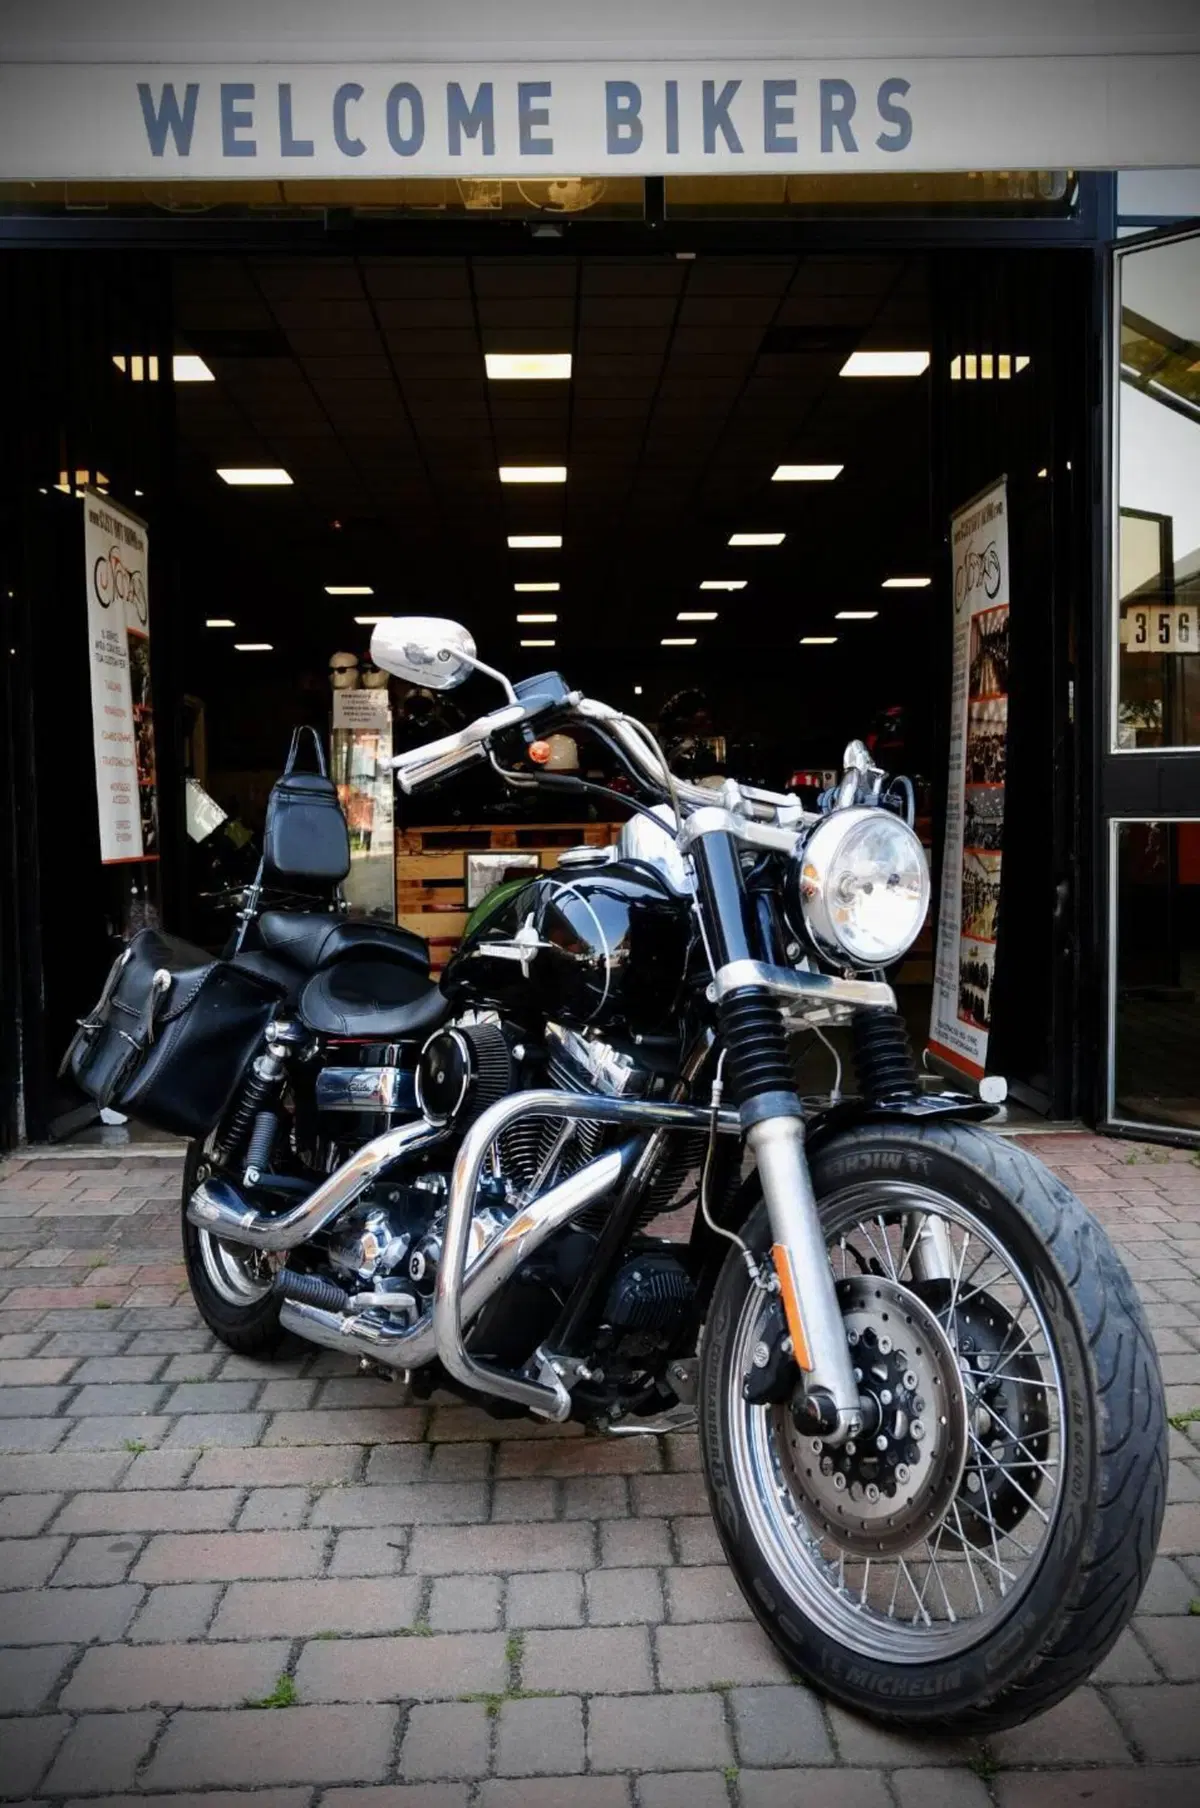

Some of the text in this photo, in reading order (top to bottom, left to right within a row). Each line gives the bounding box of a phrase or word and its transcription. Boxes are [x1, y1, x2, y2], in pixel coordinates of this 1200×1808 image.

[137, 77, 913, 157] WELCOME BIKERS
[411, 1257, 420, 1275] 8
[845, 1666, 962, 1697] MICHELIN
